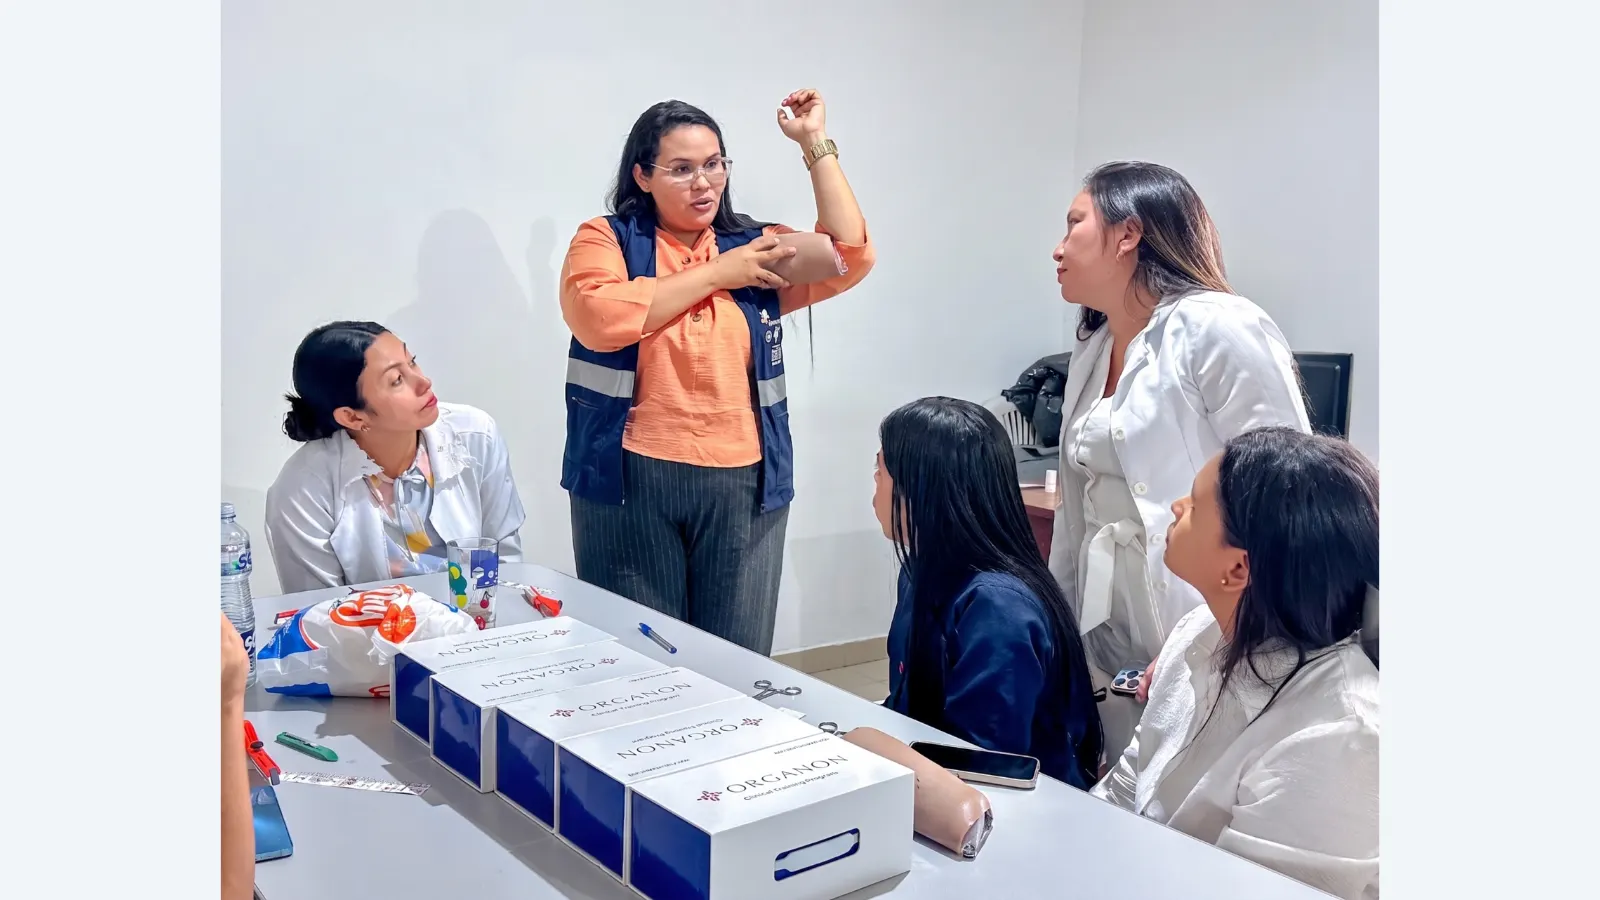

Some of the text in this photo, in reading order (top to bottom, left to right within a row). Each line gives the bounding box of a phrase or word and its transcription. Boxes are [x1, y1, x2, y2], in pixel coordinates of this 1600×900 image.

[438, 633, 548, 658] ORGANON
[481, 662, 596, 690] ORGANON
[578, 682, 692, 711] ORGANON
[616, 724, 738, 760] ORGANON
[726, 755, 849, 794] ORGANON
